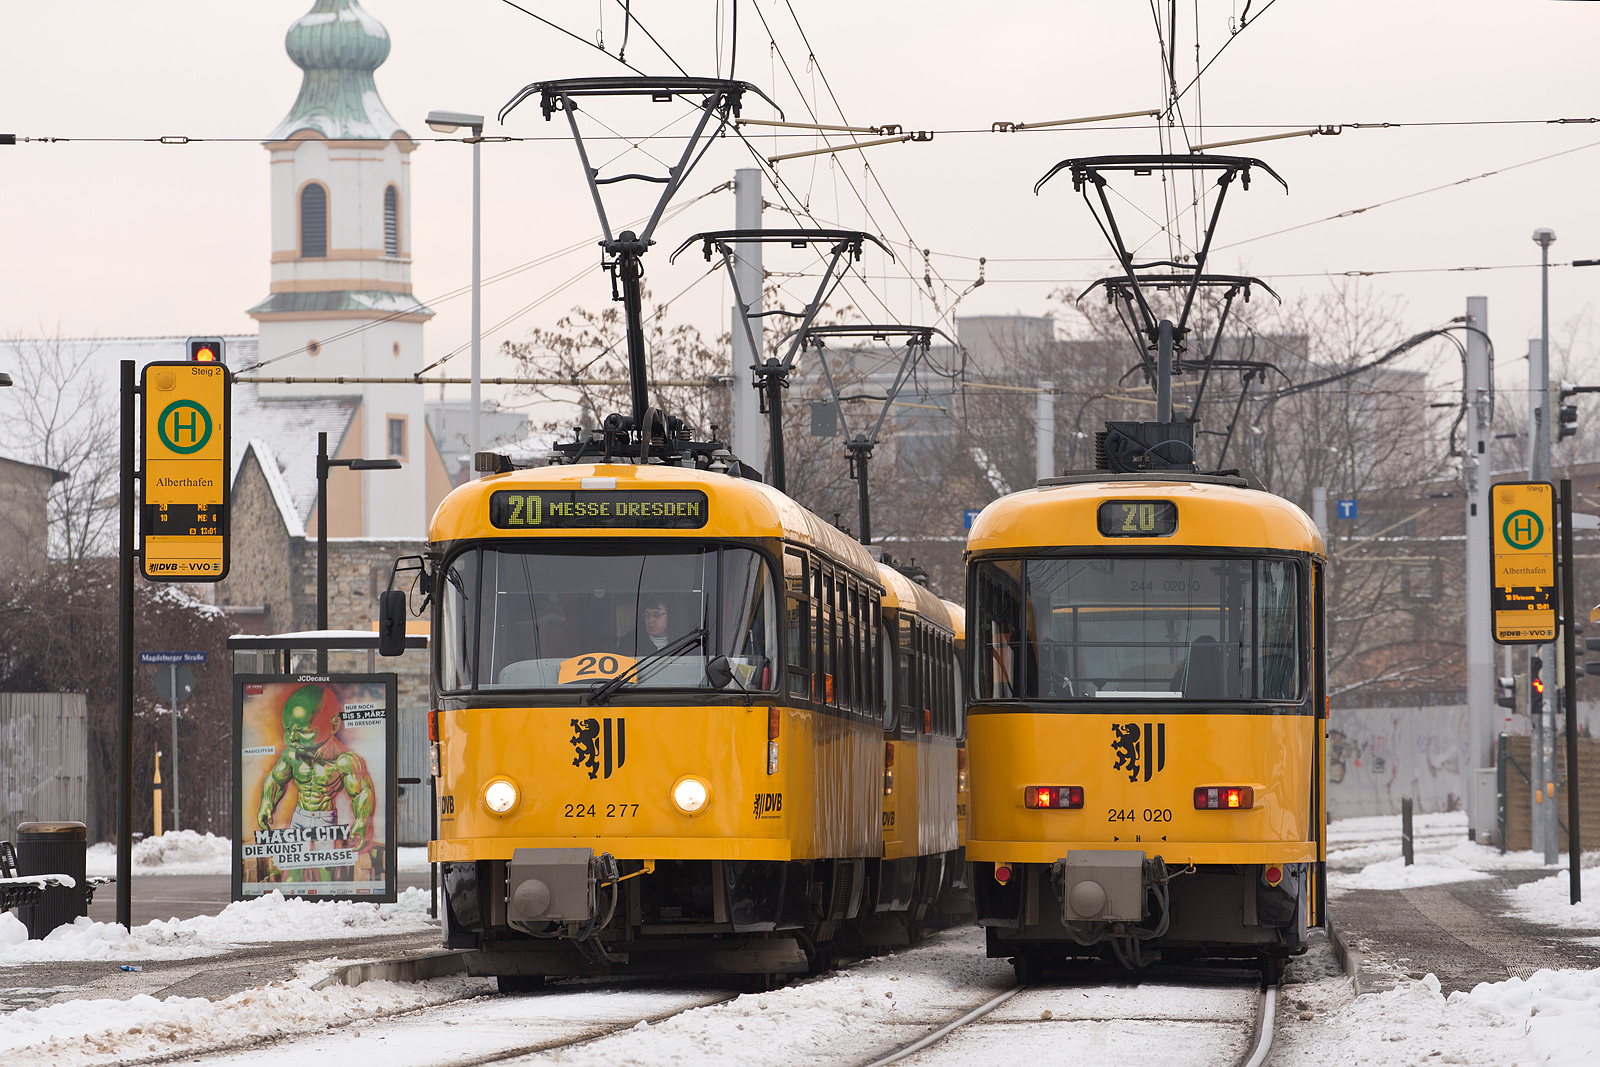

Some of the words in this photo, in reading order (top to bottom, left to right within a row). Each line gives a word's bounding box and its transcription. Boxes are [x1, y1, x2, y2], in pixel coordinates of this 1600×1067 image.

[191, 367, 213, 377] Steig
[215, 367, 221, 376] 2
[156, 478, 214, 486] Alberthafen
[508, 495, 542, 525] 20
[550, 502, 610, 516] MESSE
[616, 502, 698, 516] DRESDEN
[1122, 504, 1154, 530] 20
[160, 514, 168, 522] 10
[1131, 580, 1153, 592] 244
[142, 654, 182, 662] Magdeburger
[576, 656, 619, 676] 20
[442, 795, 454, 814] DVB
[764, 793, 782, 811] DVB
[564, 804, 596, 818] 224
[606, 804, 640, 818] 277
[1108, 808, 1135, 822] 244
[1143, 808, 1172, 822] 020
[256, 828, 312, 844] MAGIC
[316, 825, 350, 841] CITY
[245, 846, 263, 856] DIE
[266, 844, 303, 854] KUNST
[278, 854, 300, 863] DER
[304, 850, 352, 862] STRASSE
